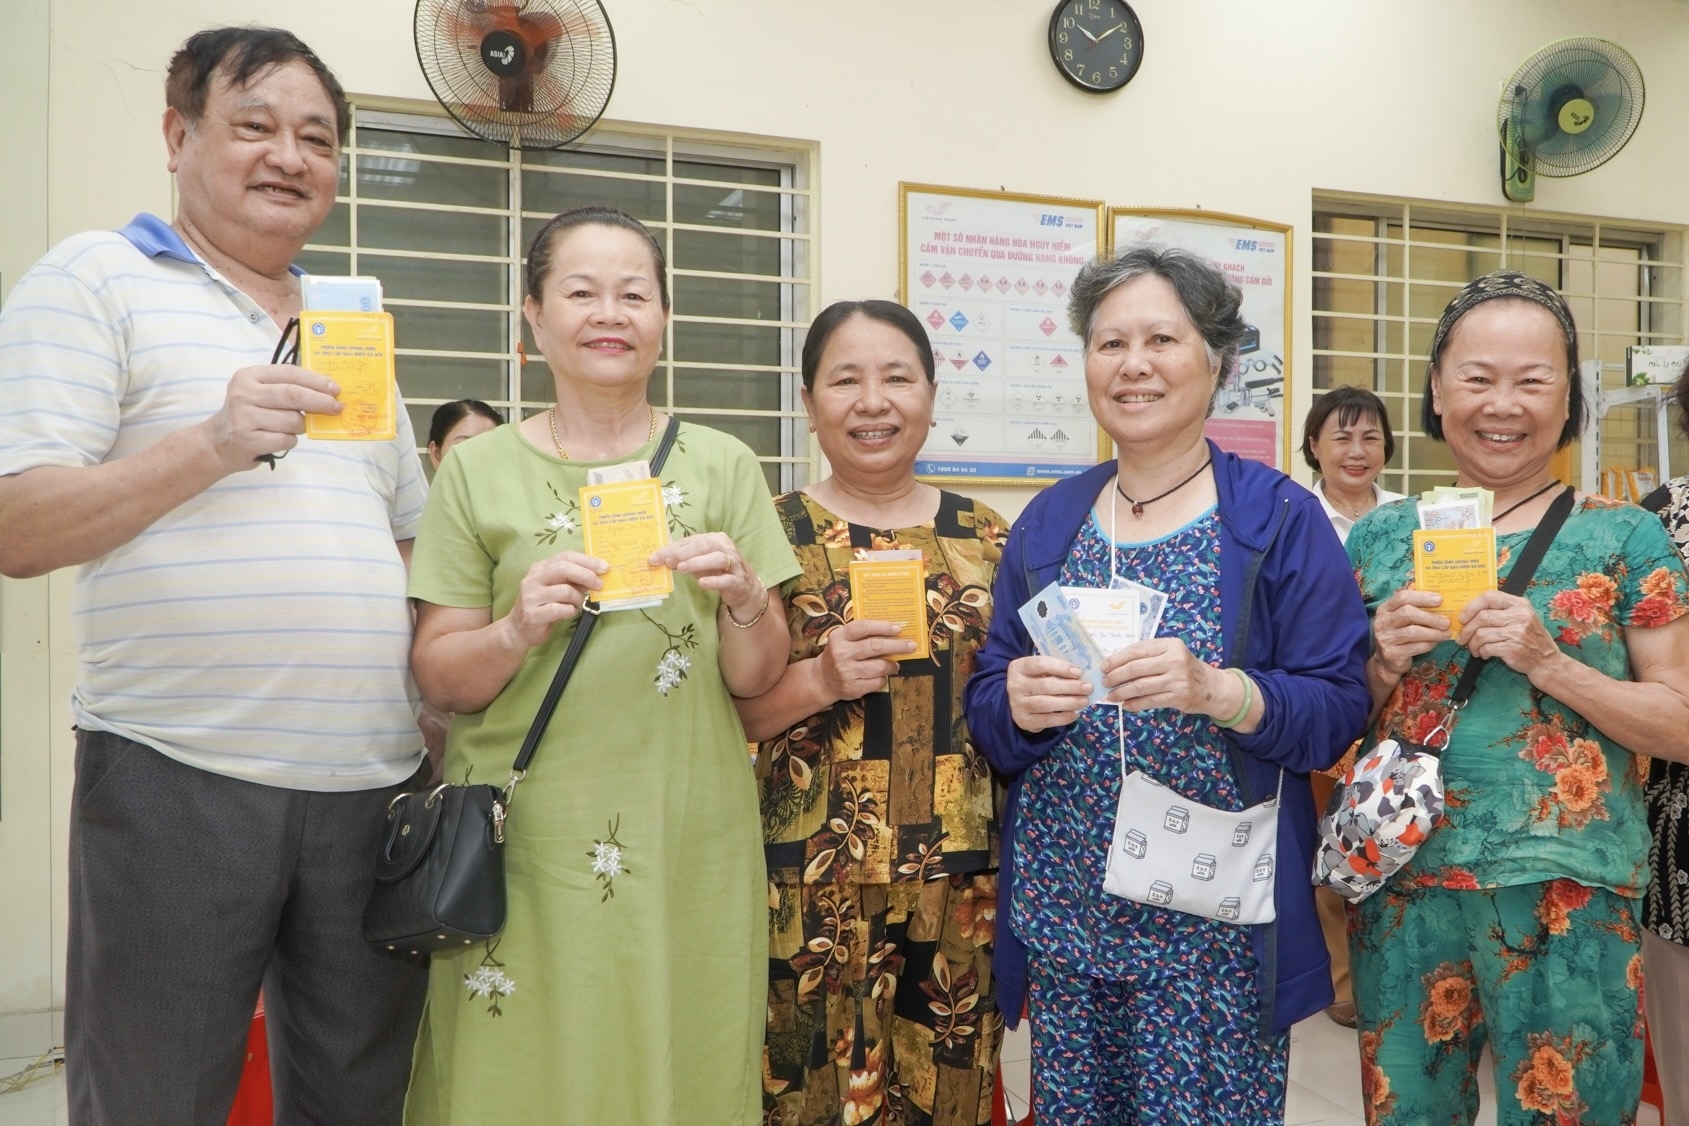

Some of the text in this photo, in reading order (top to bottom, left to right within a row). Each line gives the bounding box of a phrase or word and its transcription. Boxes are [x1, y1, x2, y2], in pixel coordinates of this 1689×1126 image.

[1074, 4, 1084, 16] 11
[1088, 0, 1100, 10] 12
[1110, 7, 1115, 18] 1
[1063, 17, 1076, 28] 10
[1120, 22, 1128, 34] 2
[1059, 32, 1068, 44] 9
[1124, 38, 1132, 50] 3
[490, 50, 505, 58] ASIA
[1064, 49, 1074, 60] 8
[1120, 53, 1128, 66] 4
[1076, 64, 1086, 76] 7
[1109, 66, 1118, 78] 5
[1092, 72, 1101, 84] 6
[1040, 214, 1064, 228] EMS
[934, 230, 950, 243] MỘT
[953, 232, 964, 243] SỐ
[1030, 240, 1050, 250] NGUY
[1235, 239, 1258, 252] EMS
[920, 241, 938, 254] CẤM
[990, 250, 1005, 260] QUA
[1224, 261, 1245, 272] KHÁCH
